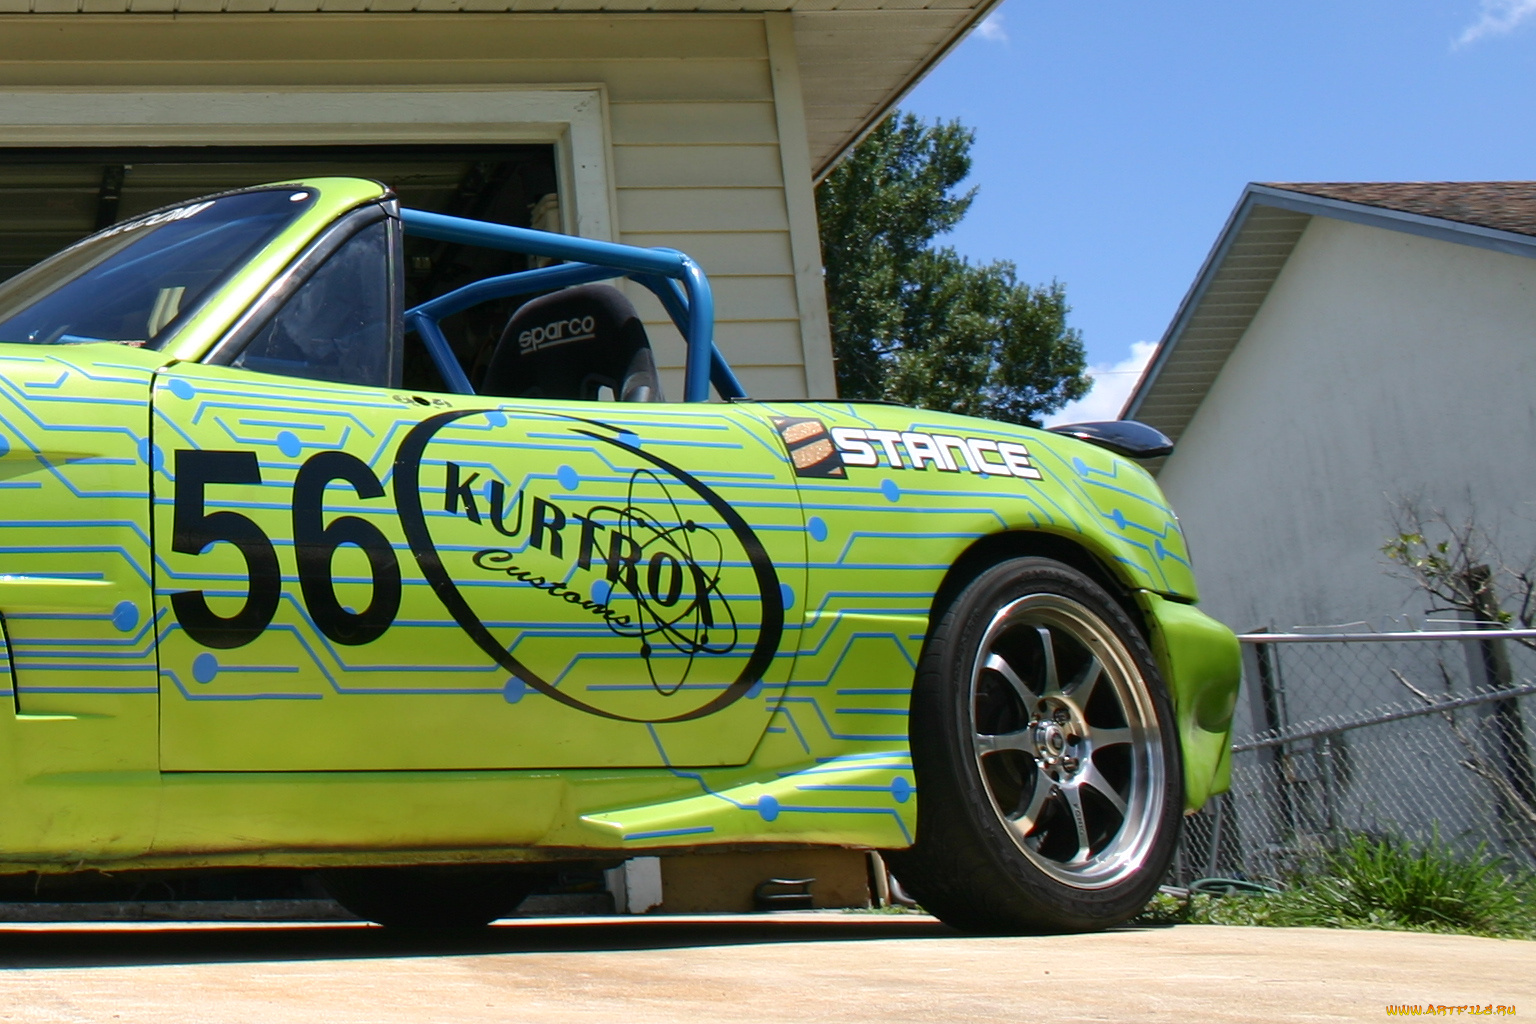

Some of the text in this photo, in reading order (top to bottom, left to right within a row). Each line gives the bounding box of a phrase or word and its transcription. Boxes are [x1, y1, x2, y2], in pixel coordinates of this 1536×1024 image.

[518, 316, 595, 351] sparco
[830, 426, 1044, 481] STANCE
[170, 449, 401, 649] 56
[472, 548, 633, 627] Customs
